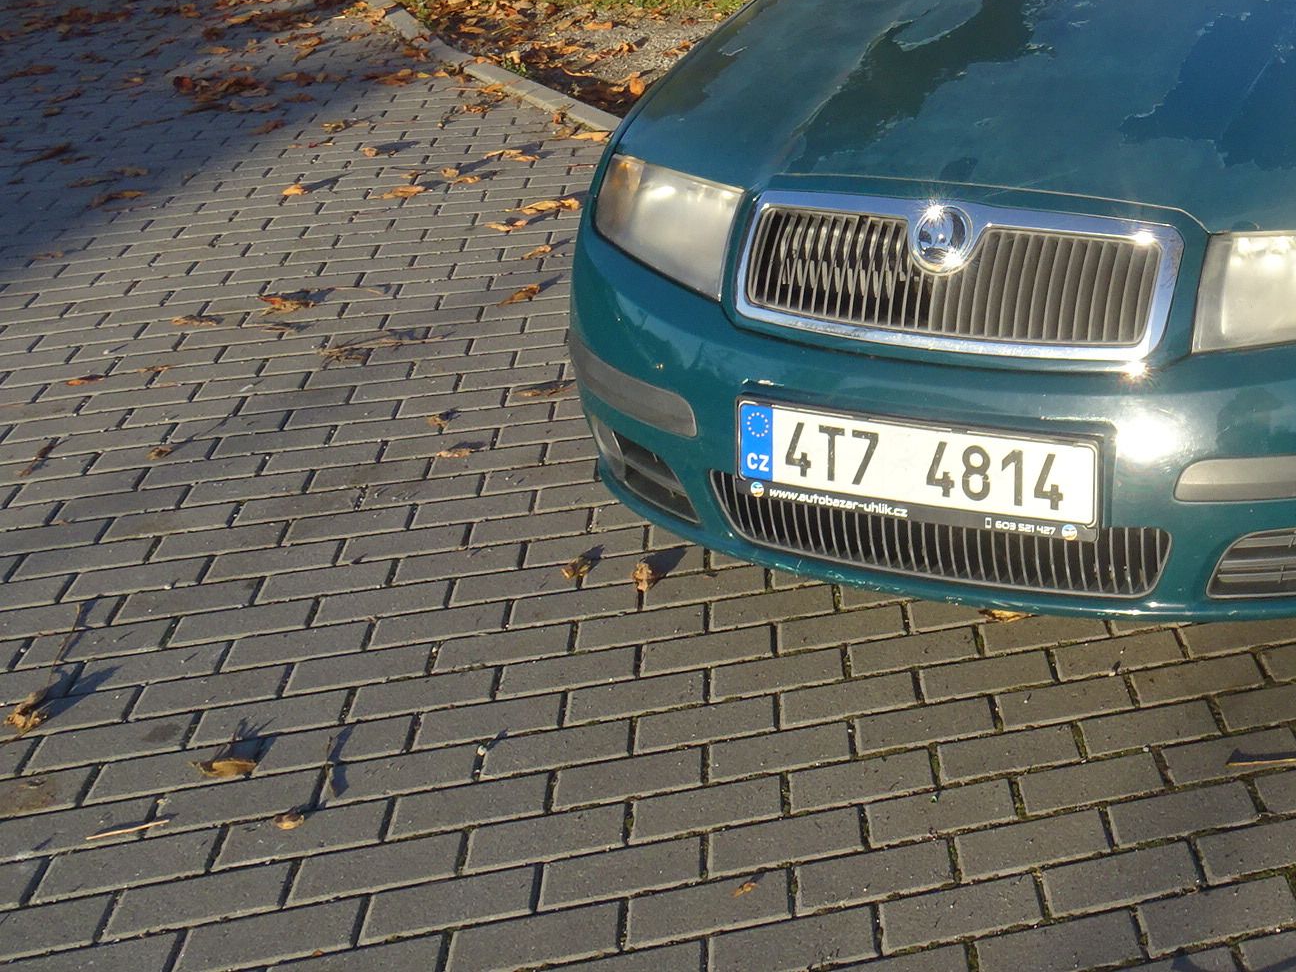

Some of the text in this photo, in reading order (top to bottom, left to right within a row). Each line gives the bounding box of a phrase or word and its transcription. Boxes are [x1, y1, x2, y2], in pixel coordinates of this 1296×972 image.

[747, 452, 770, 472] CZ
[785, 421, 1064, 511] 4T7 4814
[769, 488, 908, 518] www.autobazar-uhlik.cz
